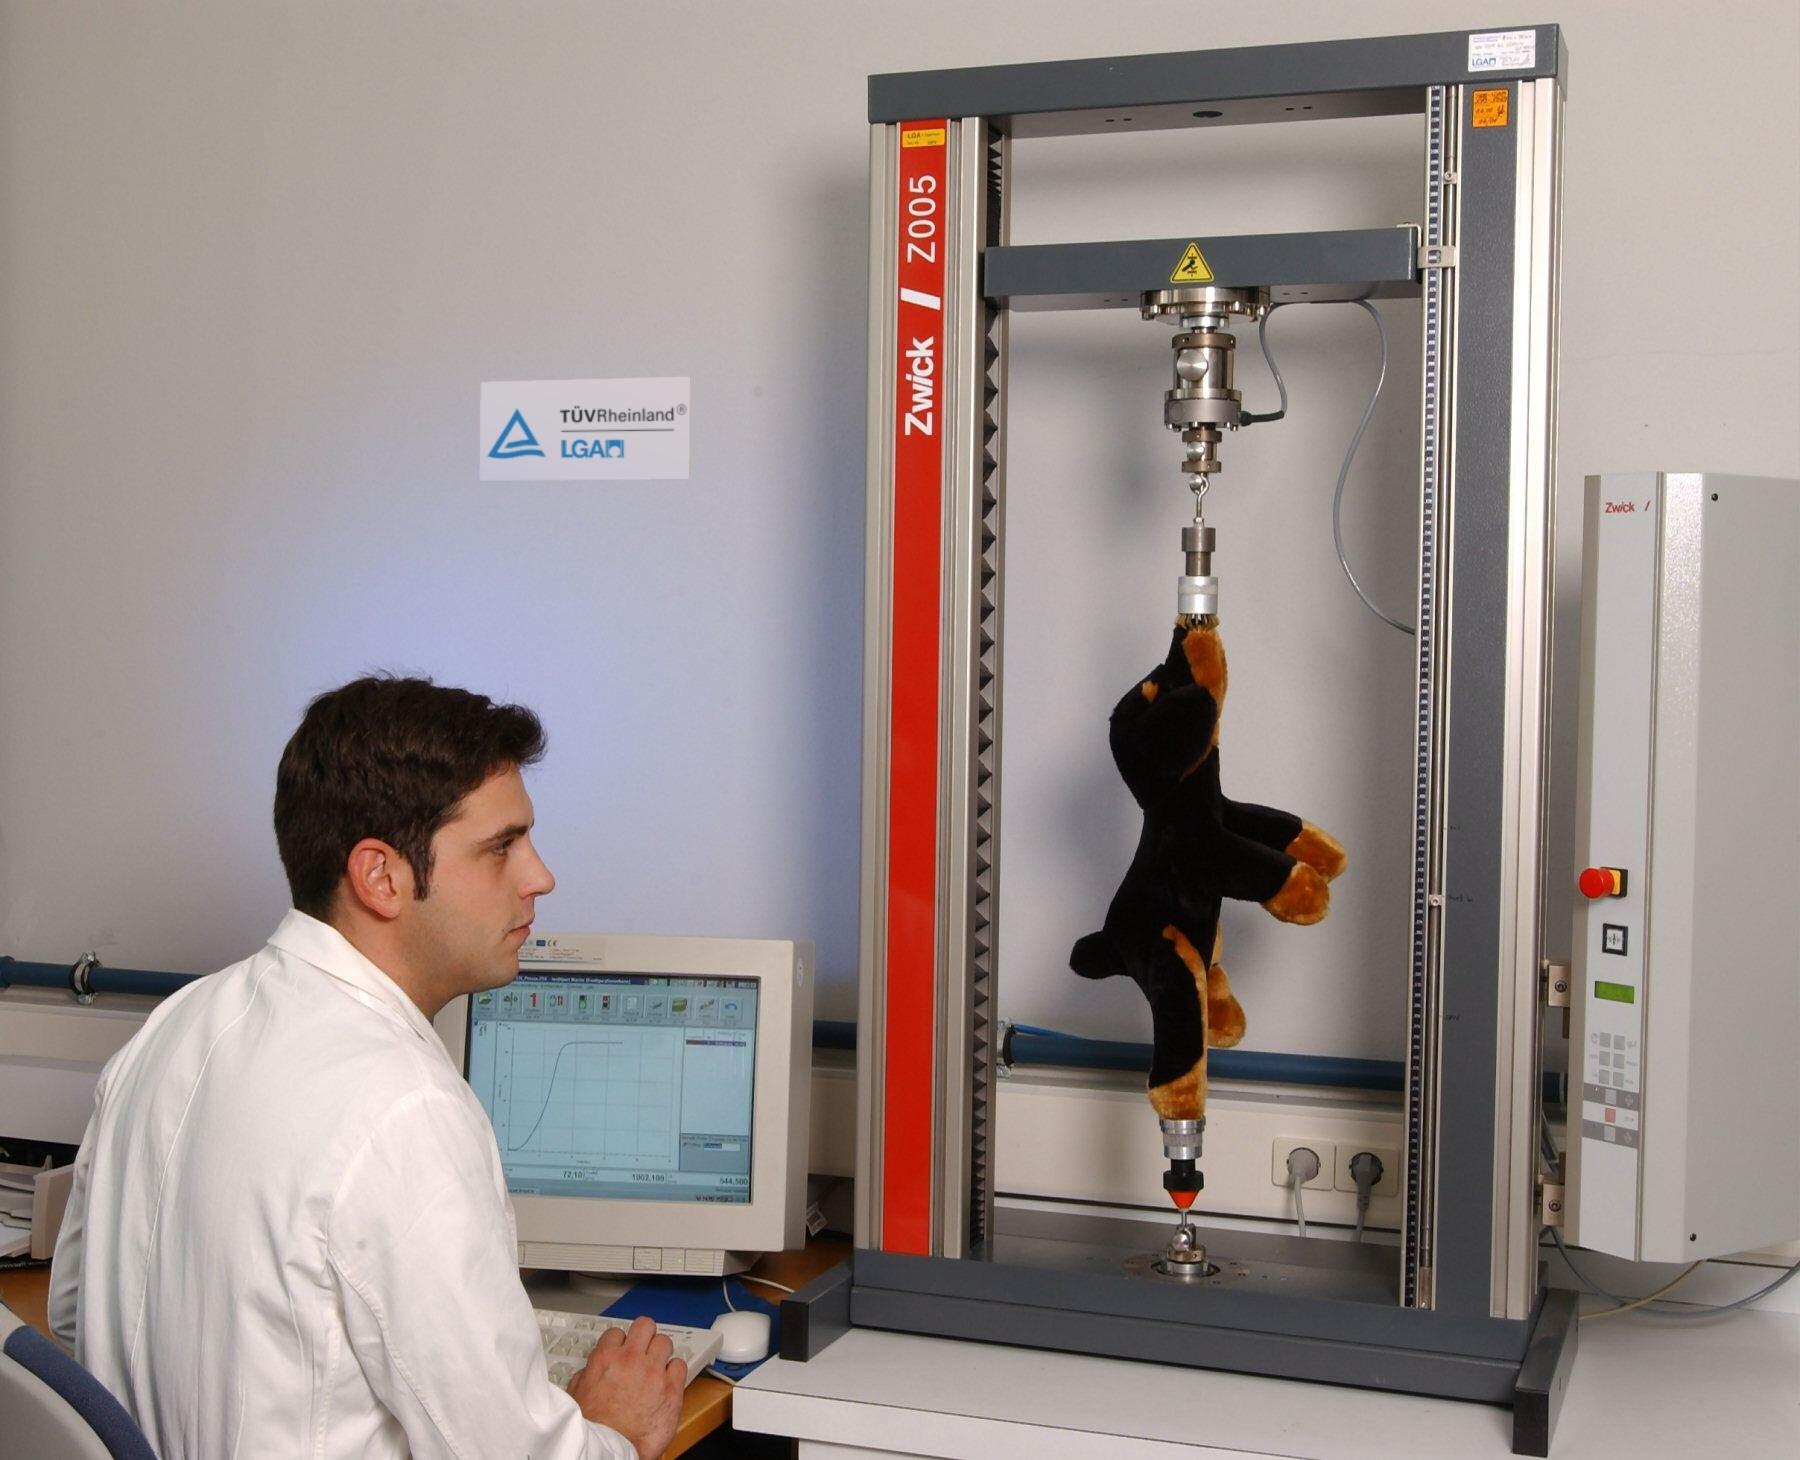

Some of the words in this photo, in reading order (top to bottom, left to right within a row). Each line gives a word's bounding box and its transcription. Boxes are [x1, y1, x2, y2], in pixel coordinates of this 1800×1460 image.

[907, 174, 937, 264] Z005
[904, 336, 935, 436] Zwick
[561, 440, 605, 458] LGA
[1605, 501, 1635, 514] Zwick
